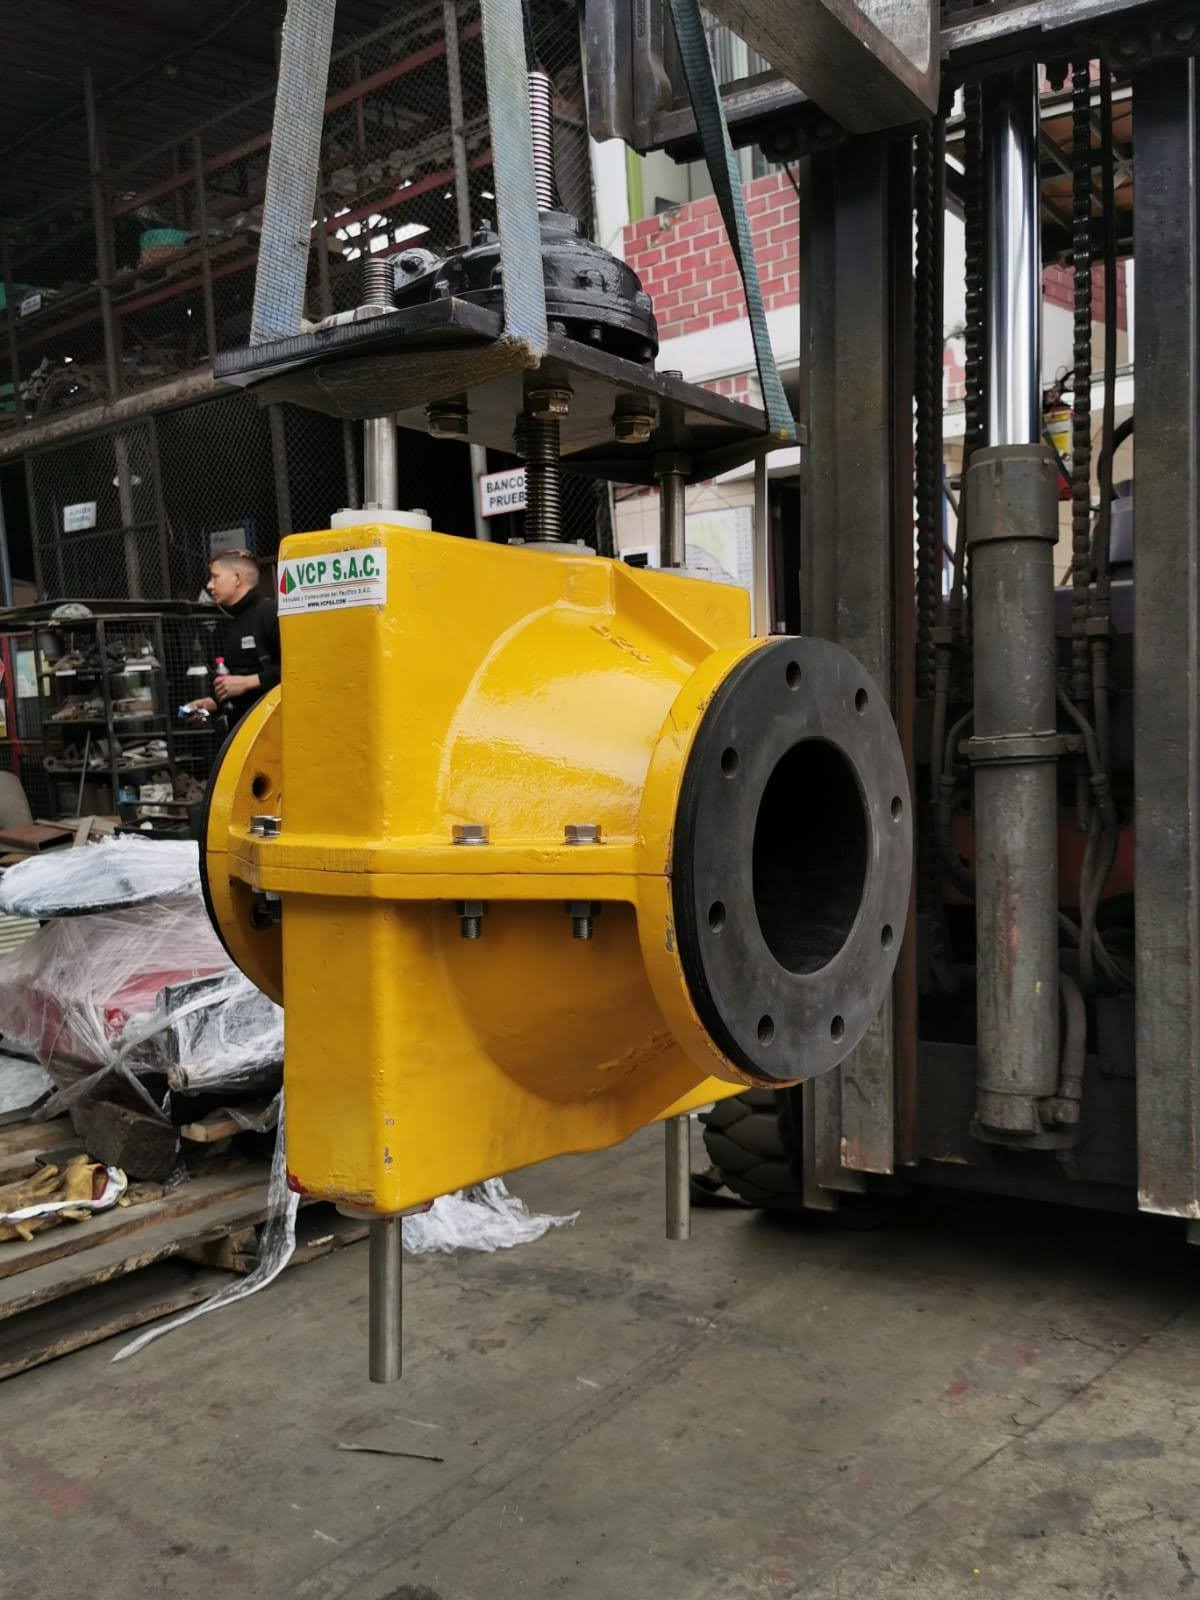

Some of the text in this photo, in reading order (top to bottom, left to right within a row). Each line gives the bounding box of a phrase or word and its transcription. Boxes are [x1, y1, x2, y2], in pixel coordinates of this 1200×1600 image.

[486, 476, 524, 493] BANCO
[296, 554, 380, 585] VCP S.A.C.
